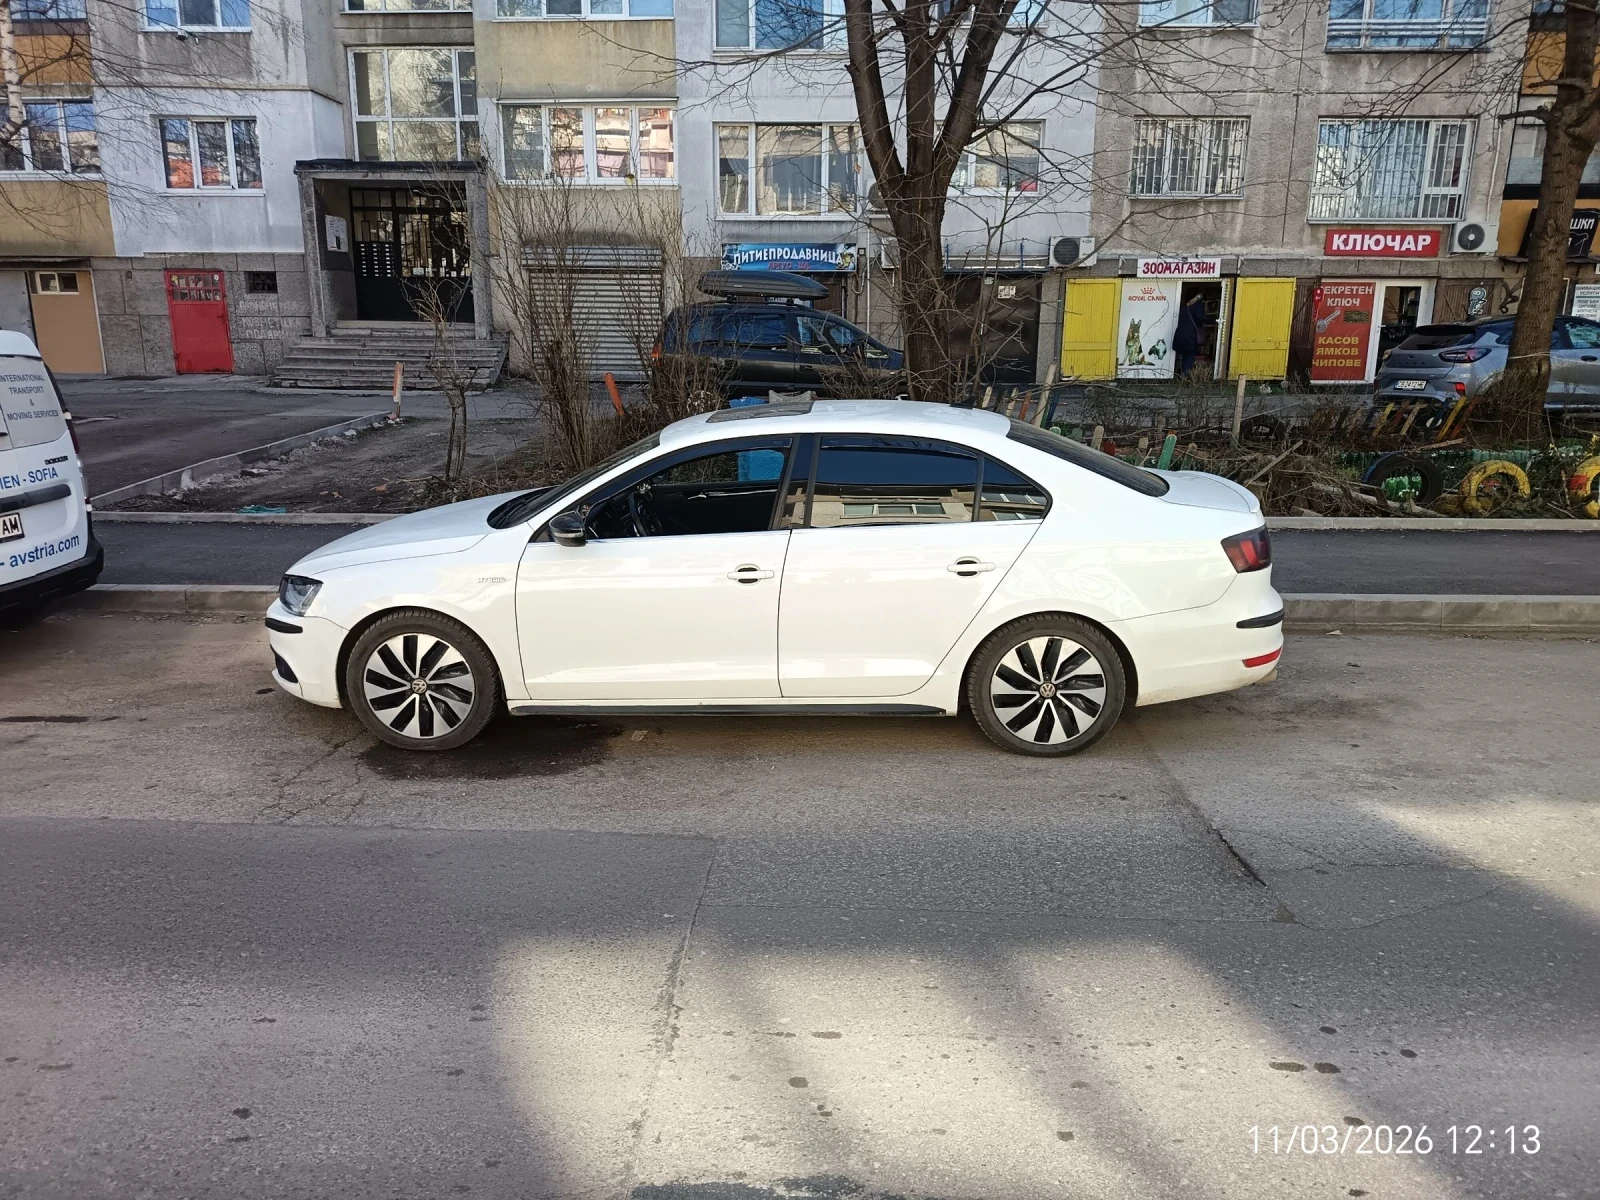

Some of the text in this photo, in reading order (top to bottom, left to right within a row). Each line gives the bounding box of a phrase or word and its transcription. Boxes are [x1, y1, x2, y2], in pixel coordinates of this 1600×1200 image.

[1331, 234, 1432, 251] КЛЮЧАР
[733, 247, 843, 266] ПИТИЕПРОДАВНИЦА
[1142, 262, 1216, 275] ЗООМАГАЗИН
[1320, 286, 1373, 295] ЕКРЕТЕН
[1327, 298, 1361, 306] КЛЮЧ
[1318, 337, 1359, 345] КАСОВ
[1315, 347, 1359, 356] ЯМКОВ
[1312, 359, 1361, 367] ЧИПОВЕ
[9, 386, 44, 394] TRANSPORT
[7, 410, 59, 421] MOVING SERVICES
[28, 467, 59, 483] SOFIA
[9, 535, 80, 568] avstria.com
